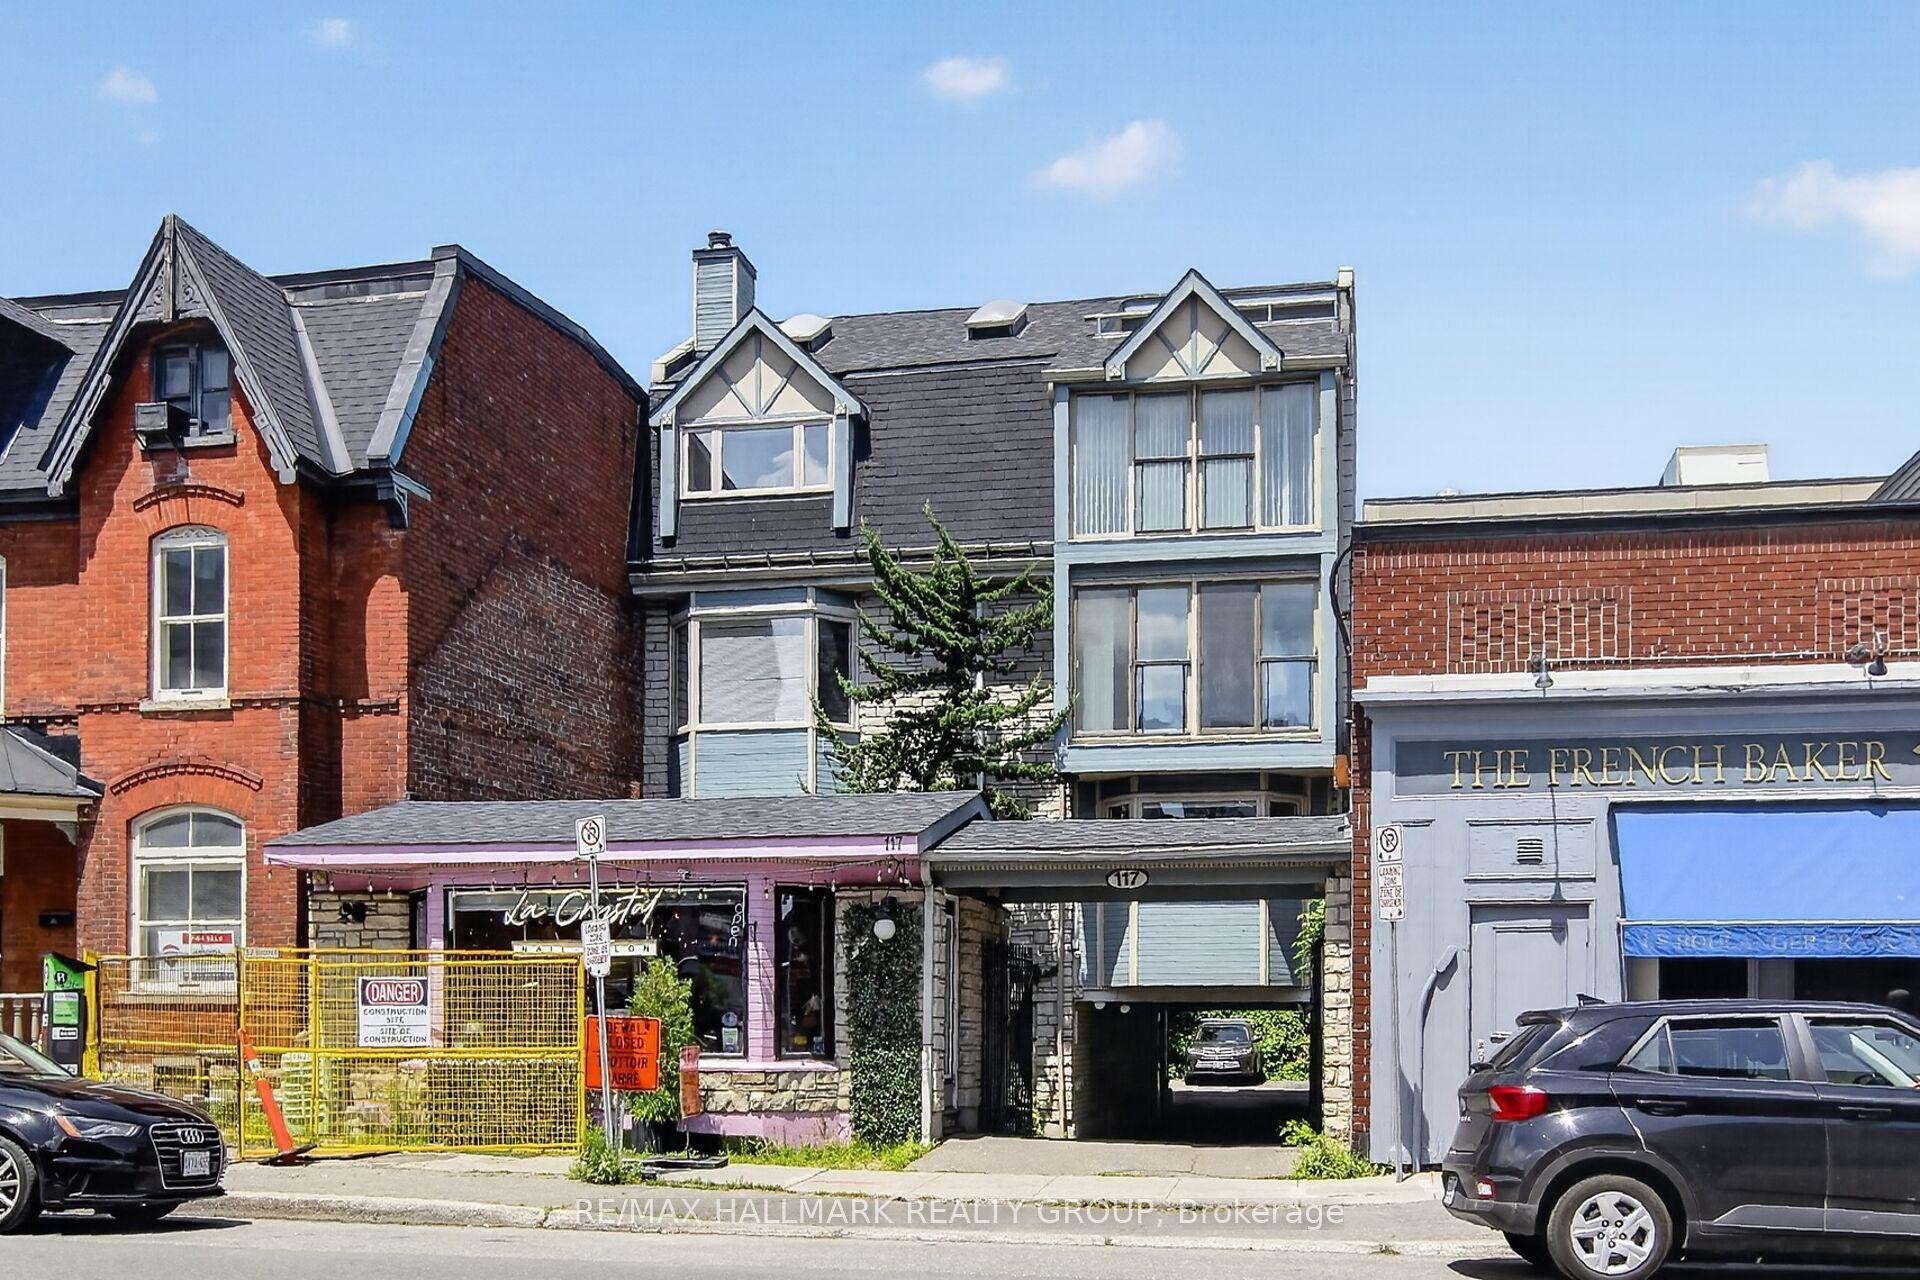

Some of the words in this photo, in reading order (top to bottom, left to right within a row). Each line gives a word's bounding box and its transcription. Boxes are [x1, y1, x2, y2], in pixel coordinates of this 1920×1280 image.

[1444, 749, 1532, 789] THE
[1548, 744, 1725, 787] FRENCH
[1742, 741, 1892, 783] BAKER
[885, 835, 903, 851] 117
[1114, 871, 1139, 886] 117
[504, 889, 546, 926] La
[521, 945, 565, 953] NAIL
[371, 983, 419, 1002] DANGER
[363, 1007, 427, 1016] CONSTRUCTION
[363, 1036, 427, 1044] CONSTRUCTION
[609, 1036, 645, 1050] LOSED
